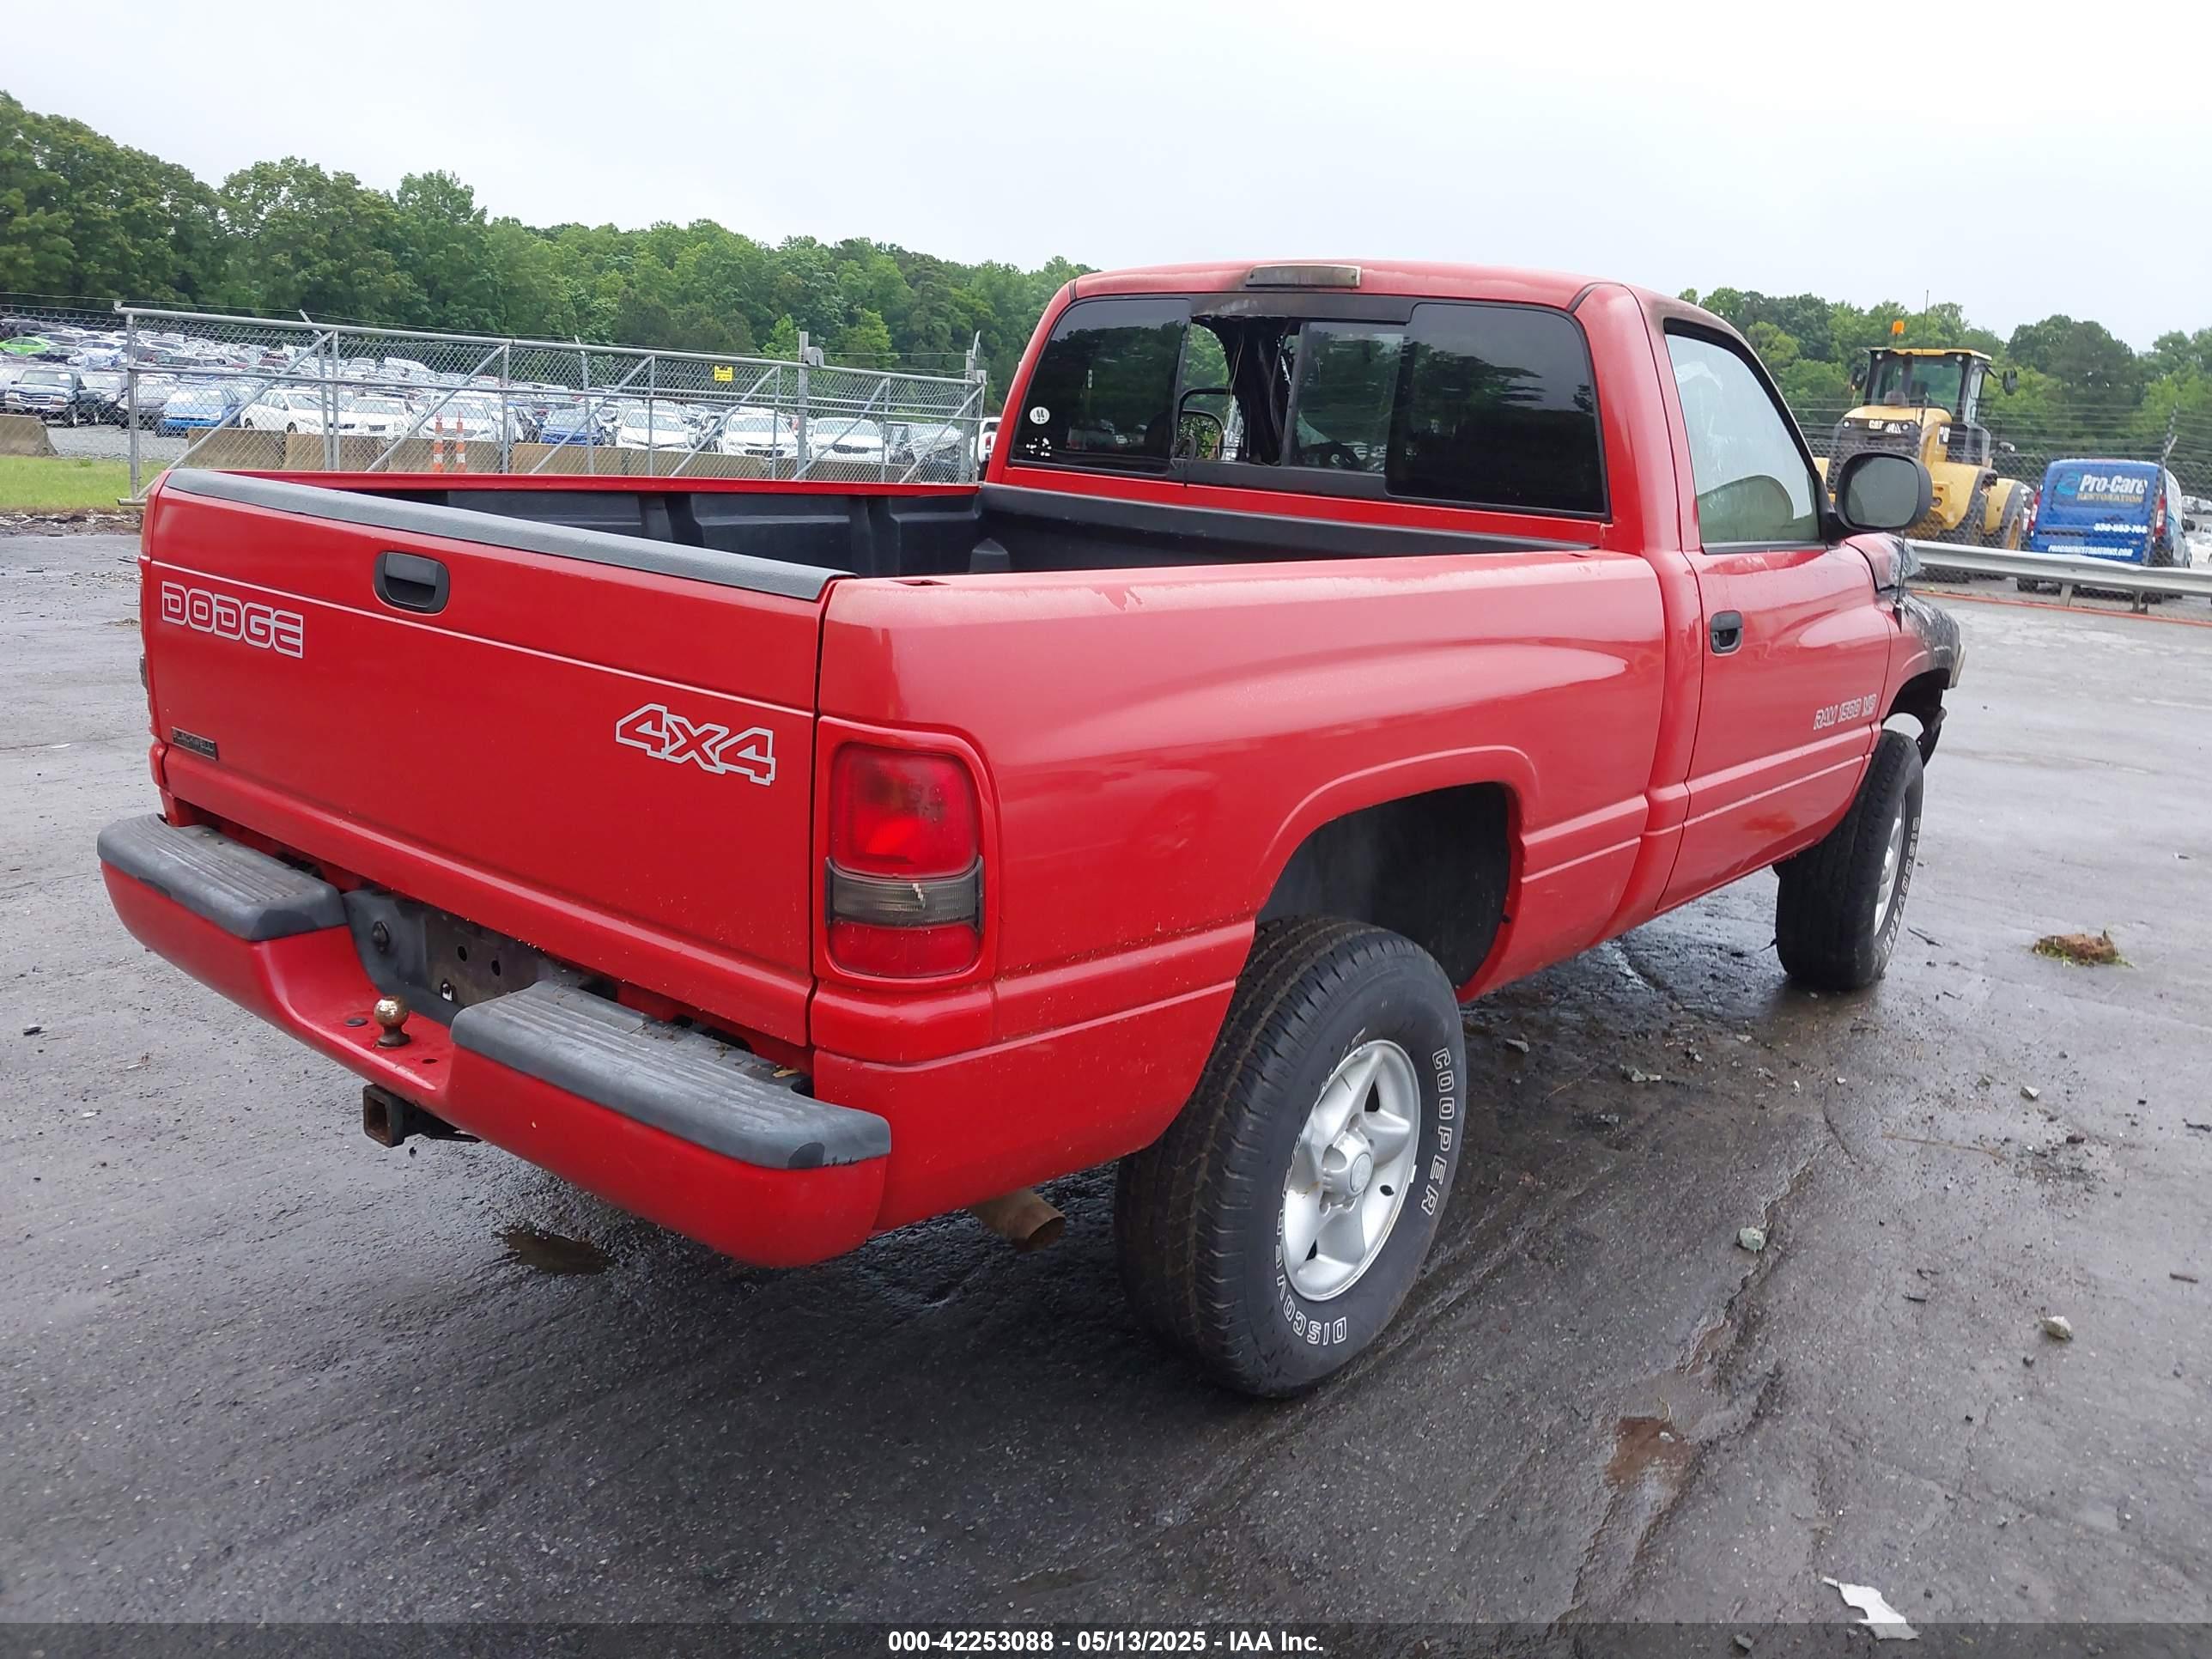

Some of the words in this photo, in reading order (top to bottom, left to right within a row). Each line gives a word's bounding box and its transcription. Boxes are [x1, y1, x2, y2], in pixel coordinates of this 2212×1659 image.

[2079, 474, 2148, 495] Pro-Care
[161, 580, 304, 659] DODGE
[1421, 1047, 1455, 1216] COOPER
